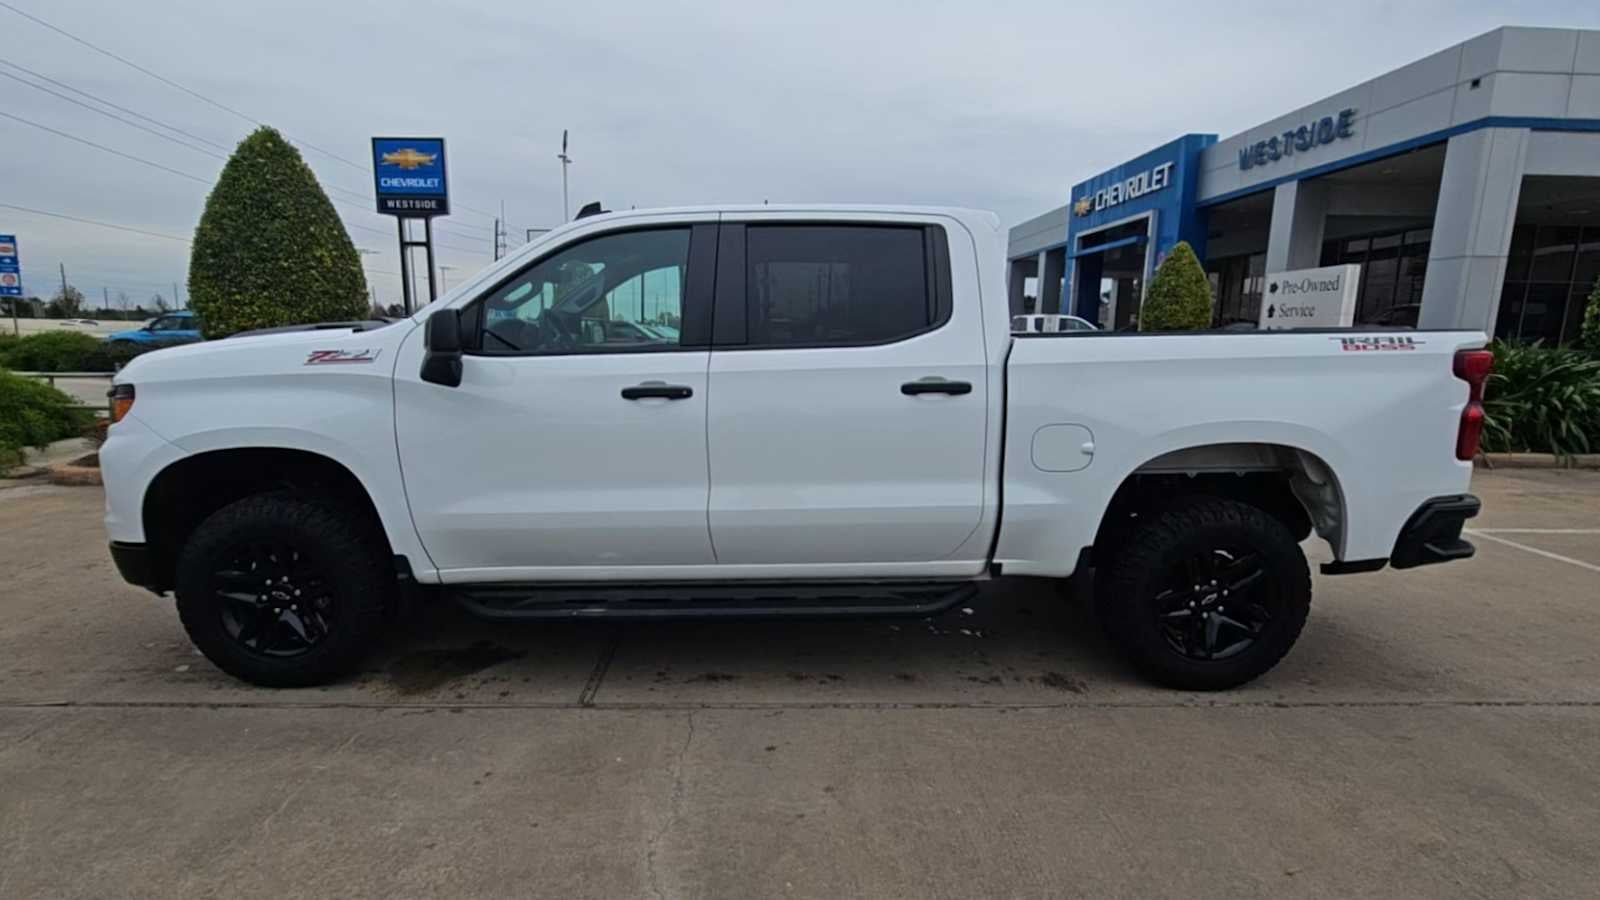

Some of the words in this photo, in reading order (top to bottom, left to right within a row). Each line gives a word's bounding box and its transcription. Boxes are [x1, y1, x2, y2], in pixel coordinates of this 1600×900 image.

[1238, 108, 1357, 171] WESTSIDE
[380, 177, 440, 187] CHEVROLET
[1095, 161, 1174, 211] CHEVROLET
[386, 200, 437, 208] WESTSIDE
[1281, 274, 1340, 294] Pre-Owned
[1279, 303, 1315, 318] Service
[1328, 336, 1426, 344] TRAIL
[1342, 344, 1415, 352] BOSS
